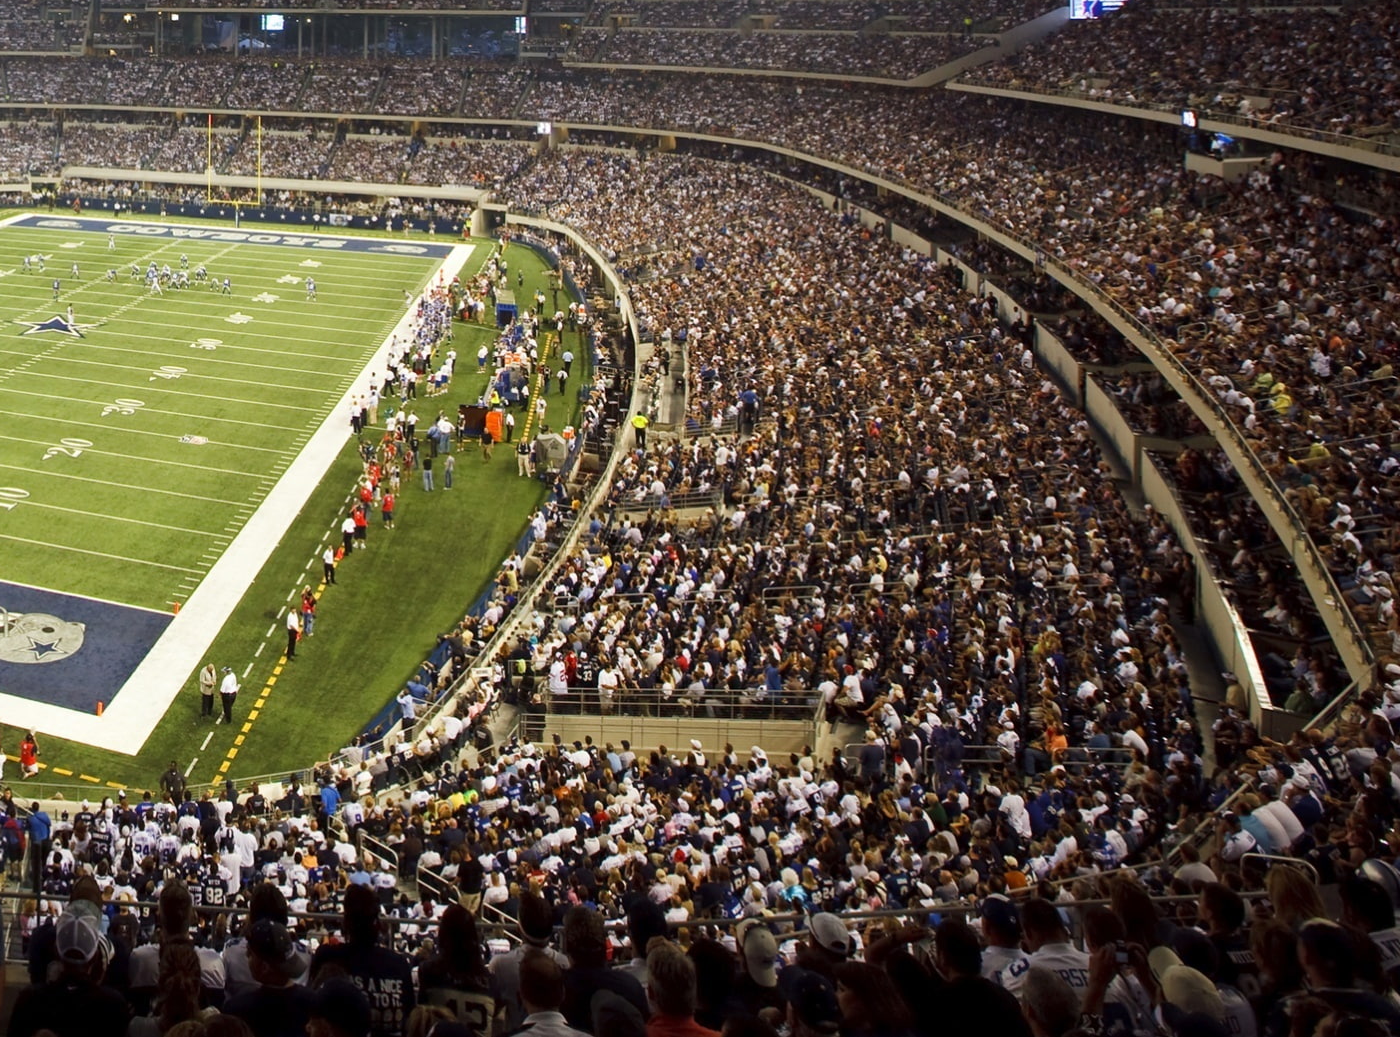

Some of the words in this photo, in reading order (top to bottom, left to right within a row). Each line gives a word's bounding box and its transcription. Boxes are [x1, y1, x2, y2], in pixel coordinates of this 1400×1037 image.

[106, 224, 348, 248] COWBOYS
[103, 398, 145, 415] 30
[46, 437, 94, 458] 20
[380, 978, 404, 994] NICE
[373, 993, 390, 1007] TO
